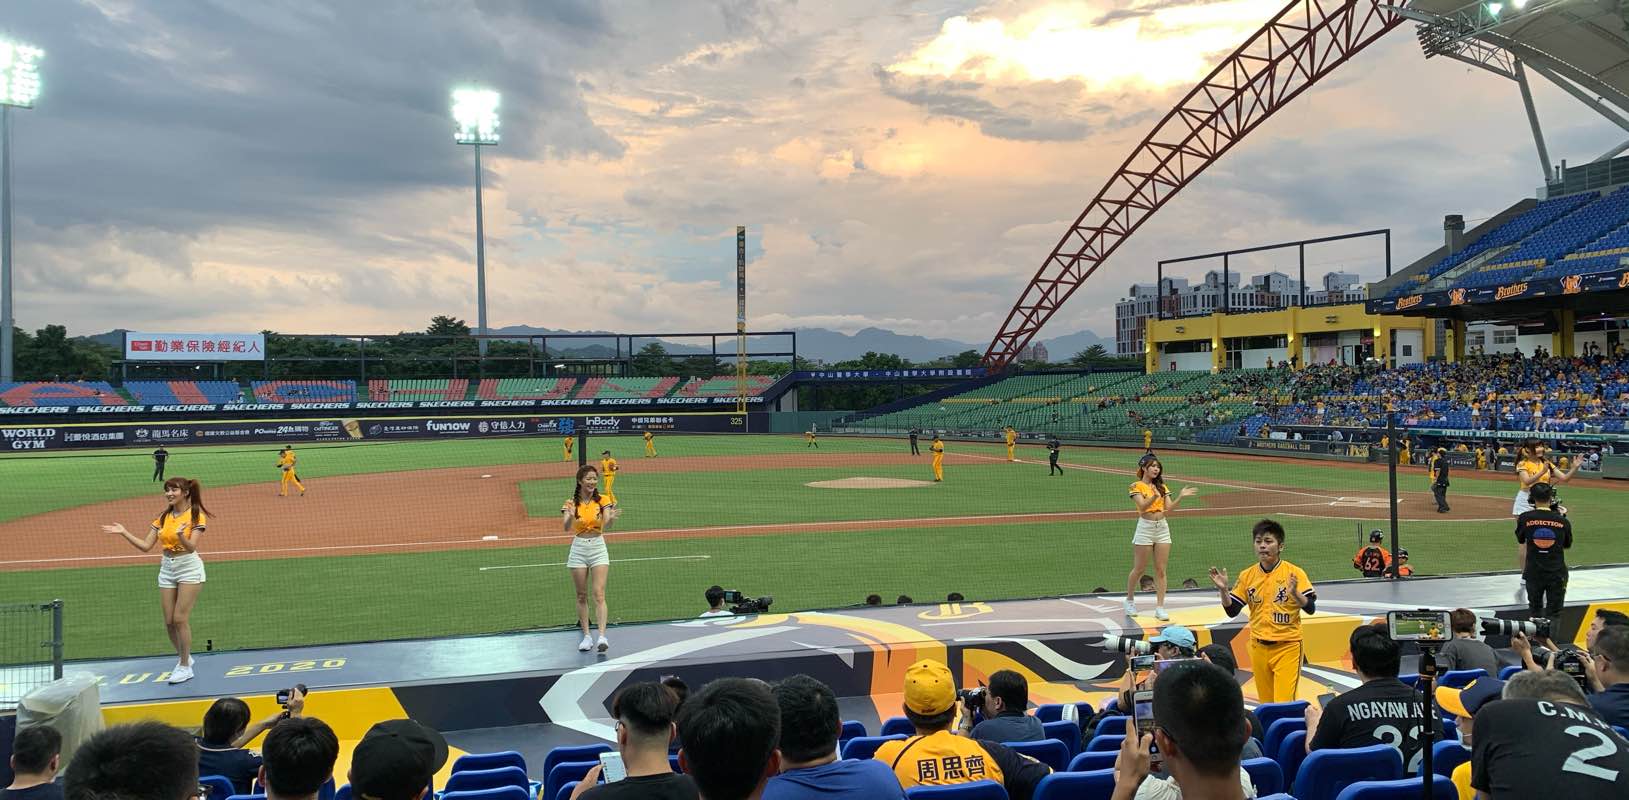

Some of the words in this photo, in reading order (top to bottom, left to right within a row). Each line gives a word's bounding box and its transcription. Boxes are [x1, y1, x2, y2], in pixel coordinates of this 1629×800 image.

[1495, 282, 1528, 300] Brothers
[1396, 294, 1423, 310] Brothers
[154, 339, 261, 353] 勤業保險經紀人
[76, 405, 145, 413] SKECHERS
[151, 404, 216, 412] SKECHERS
[222, 403, 284, 411] SKECHERS
[291, 402, 350, 410] SKECHERS
[356, 401, 413, 409] SKECHERS
[419, 400, 476, 408] SKECHERS
[480, 399, 535, 407] SKECHERS
[490, 421, 525, 430] 守信人力
[586, 416, 620, 427] InBody
[730, 417, 743, 425] 325
[1, 428, 56, 438] WORLD
[12, 440, 46, 449] GYM
[1526, 519, 1564, 529] ADDICTION
[1364, 557, 1380, 571] 62
[1273, 612, 1290, 624] 100
[227, 658, 348, 678] 2020
[1347, 701, 1438, 721] NGAYAW.AE
[917, 754, 985, 782] 周思齊
